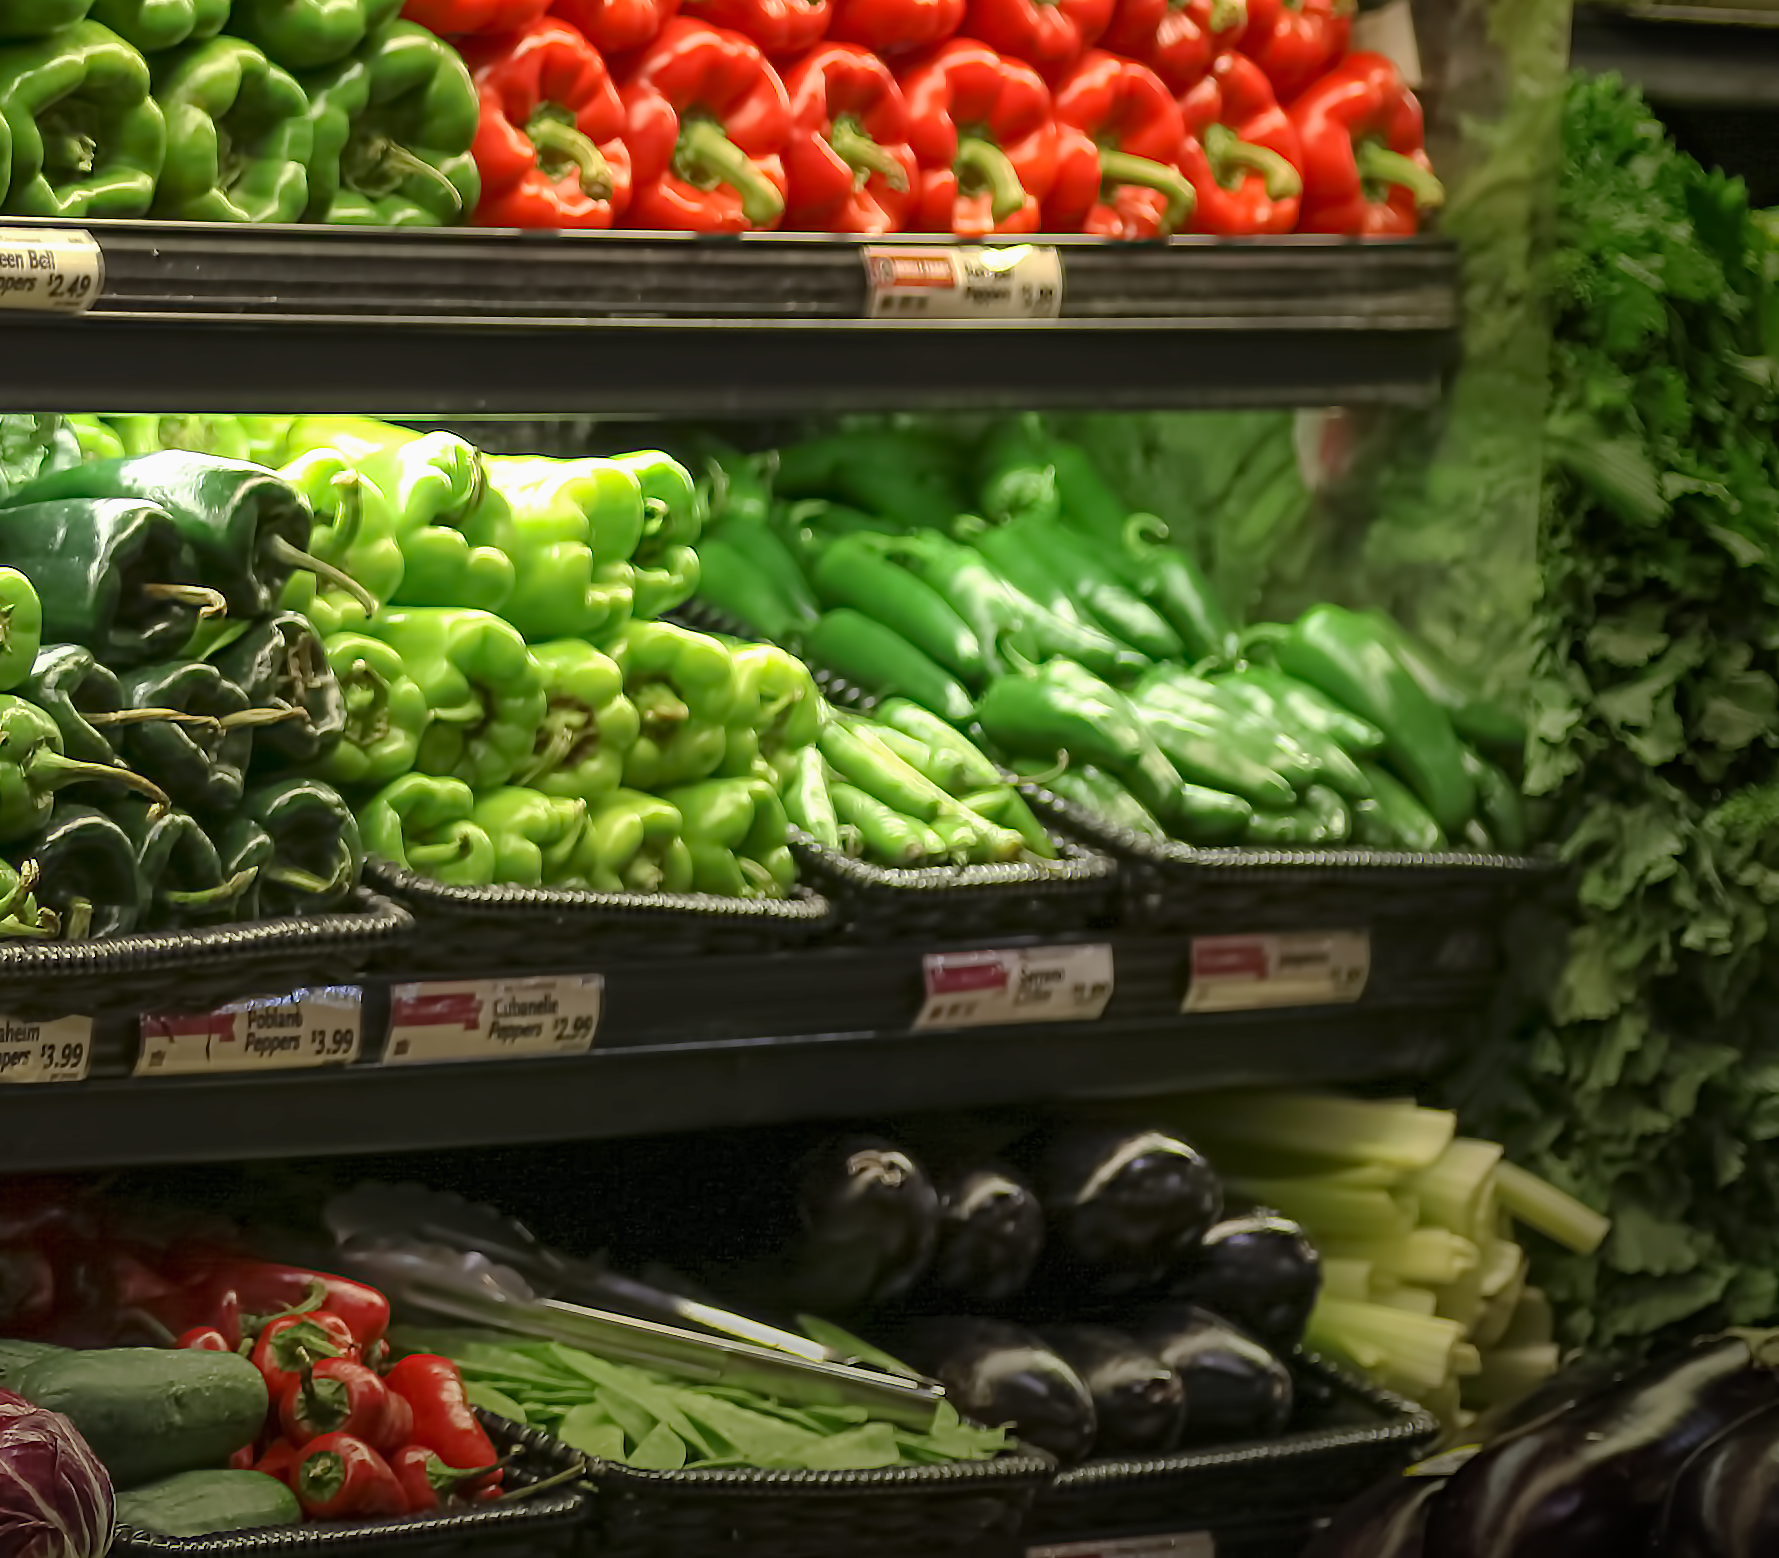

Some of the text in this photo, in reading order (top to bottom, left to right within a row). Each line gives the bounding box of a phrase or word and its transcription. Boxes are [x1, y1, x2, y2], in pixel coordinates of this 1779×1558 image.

[29, 249, 56, 270] Bell
[47, 274, 92, 299] $2.49
[245, 1031, 301, 1058] Peppers
[488, 1021, 543, 1045] Peppers
[41, 1042, 84, 1070] $3.99
